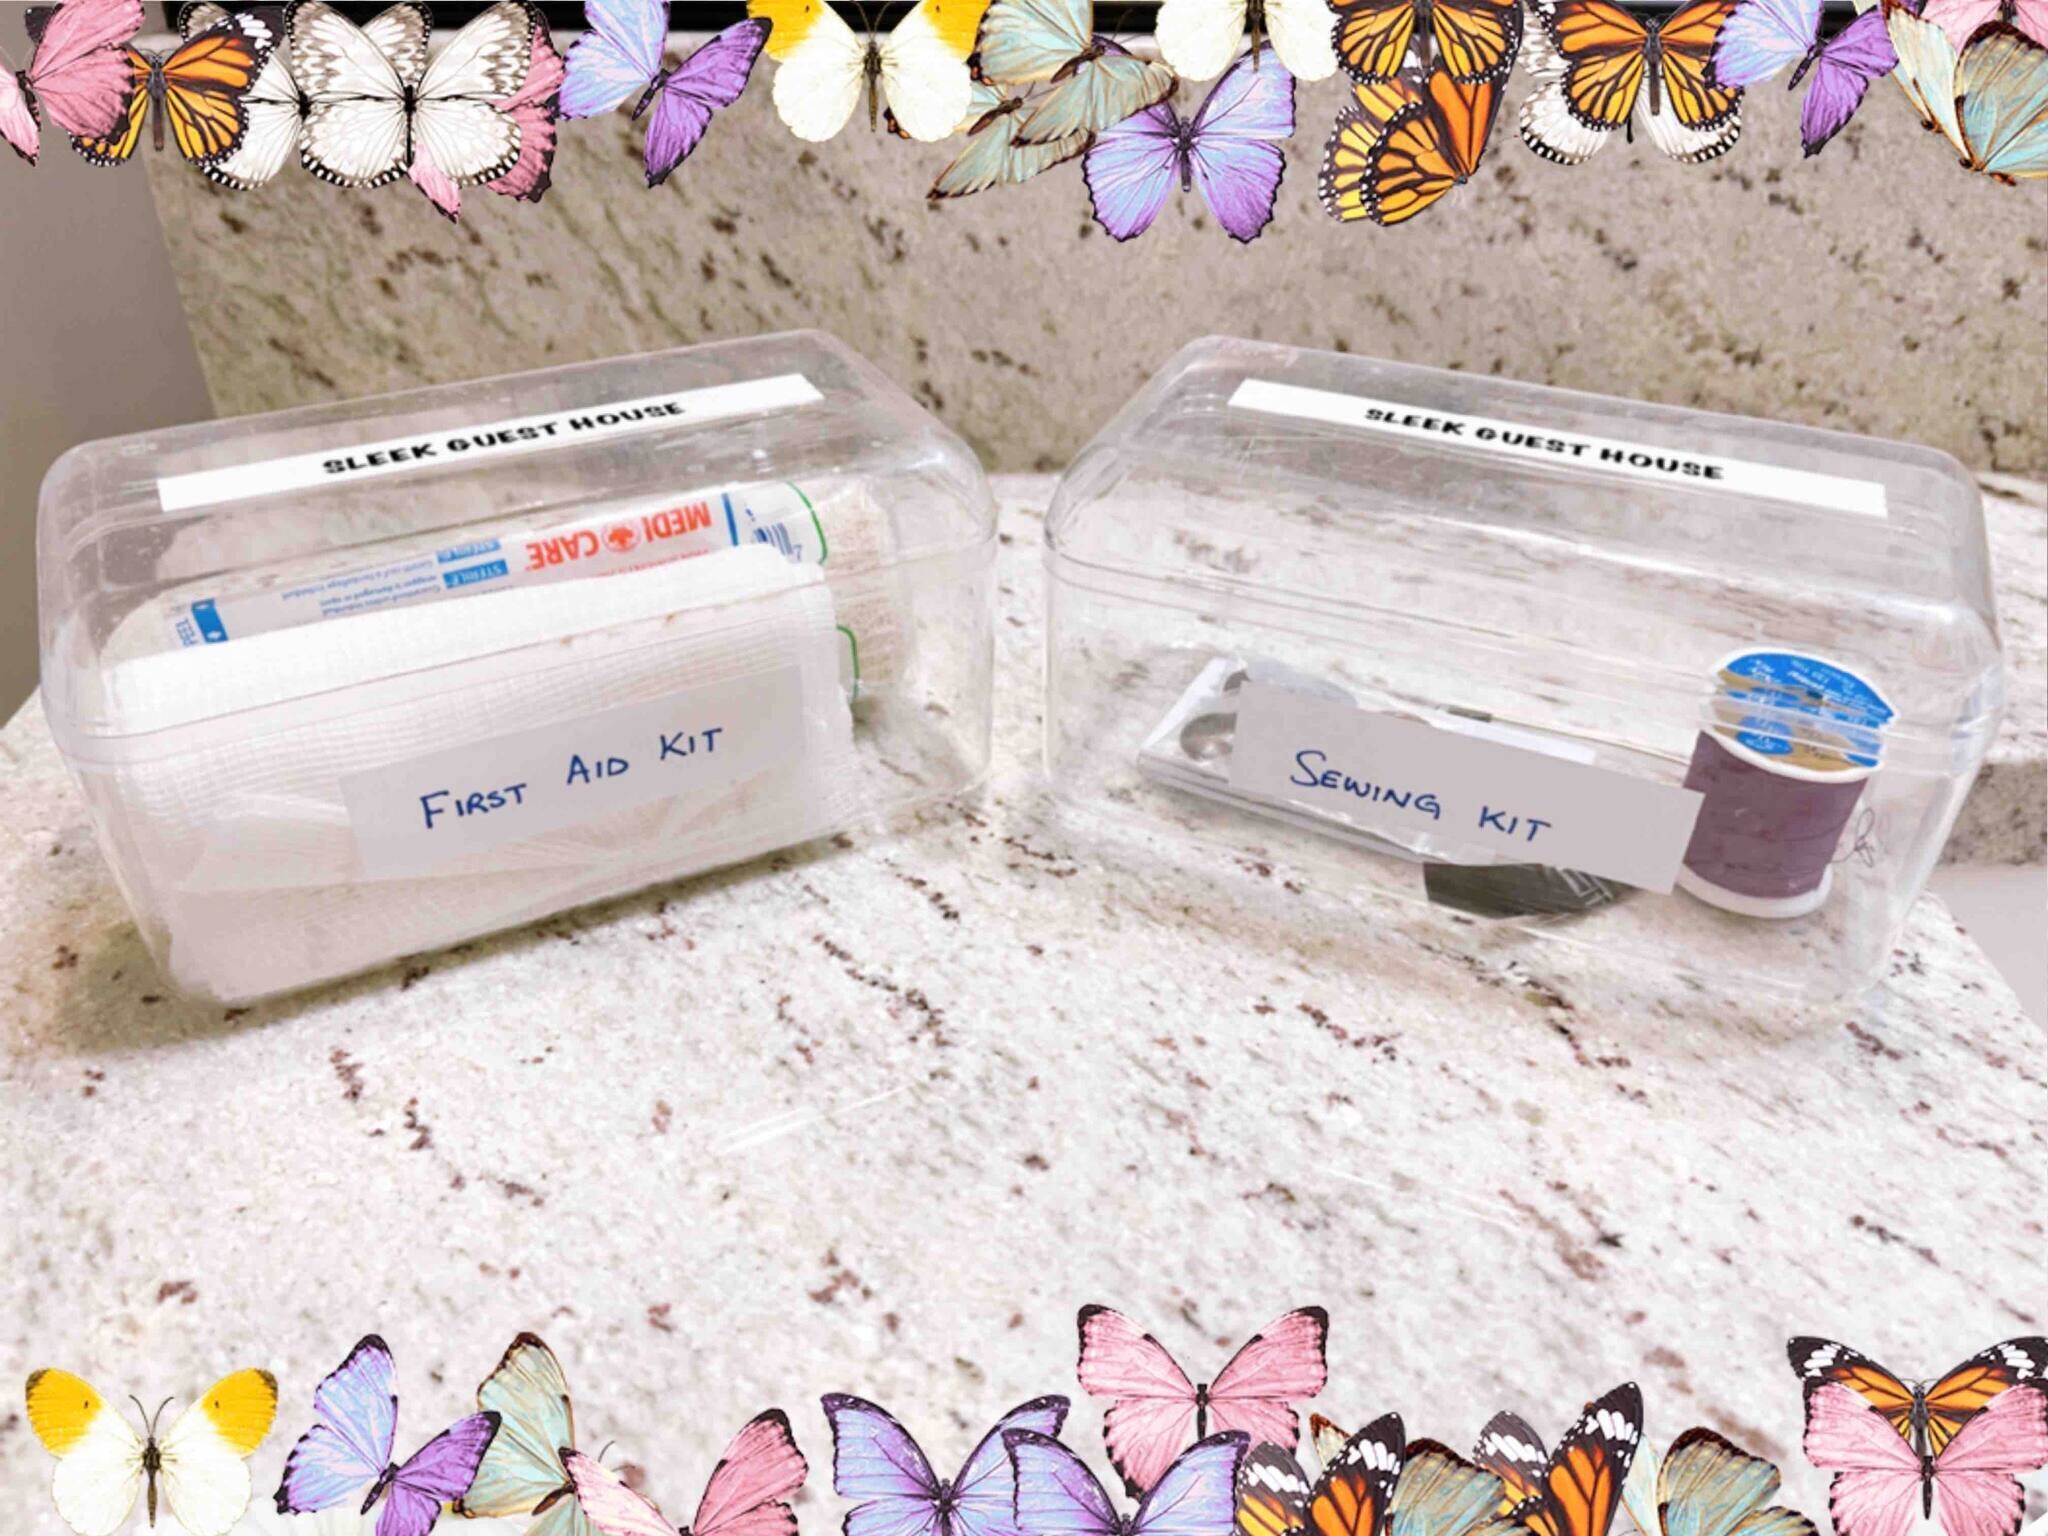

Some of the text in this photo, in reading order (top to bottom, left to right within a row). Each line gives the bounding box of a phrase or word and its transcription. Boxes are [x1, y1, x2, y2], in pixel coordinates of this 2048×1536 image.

[322, 402, 686, 475] SLEEK GUEST HOUSE
[1364, 408, 1724, 480] SLEEK GUEST HOUSE
[528, 530, 600, 570] CARE
[641, 502, 712, 543] MEDI
[418, 727, 723, 830] FIRST AID KIT
[1289, 749, 1552, 843] SEWING KIT
